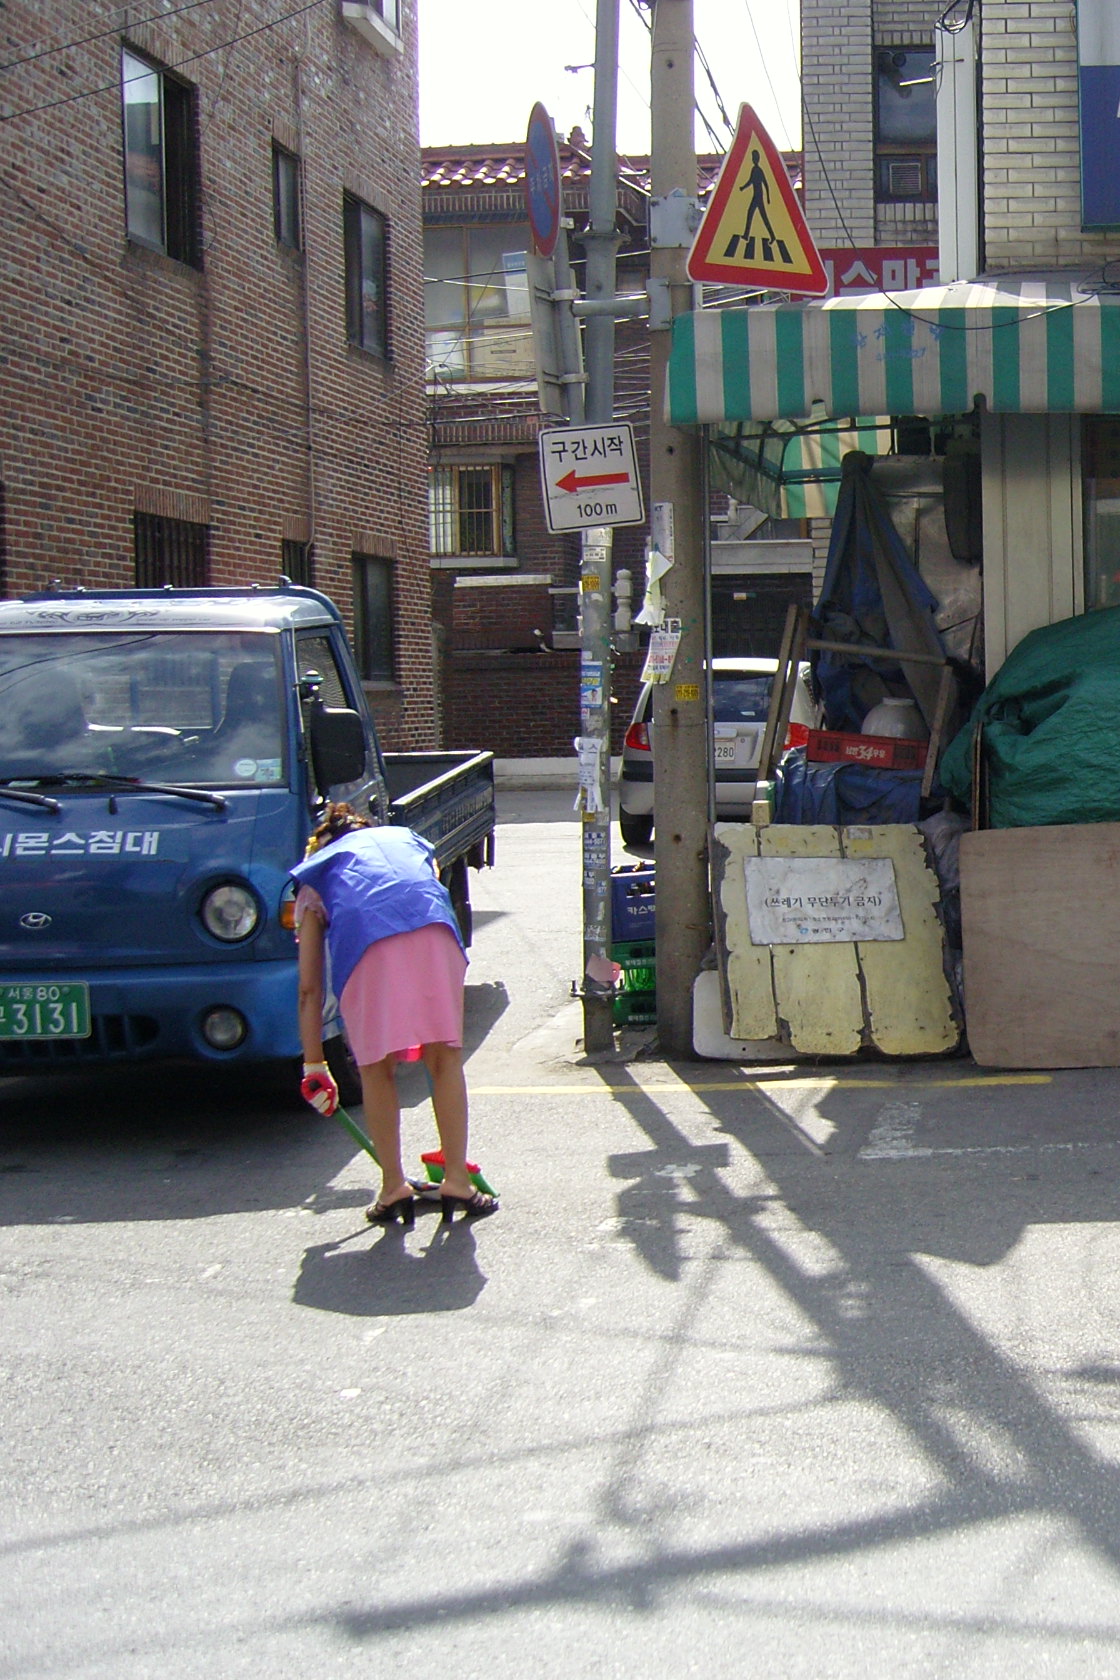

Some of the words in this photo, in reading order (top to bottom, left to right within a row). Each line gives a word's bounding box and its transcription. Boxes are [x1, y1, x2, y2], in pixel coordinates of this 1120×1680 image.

[551, 435, 624, 463] 구간시작
[764, 895, 803, 908] (쓰레기
[807, 895, 851, 908] 무단투기
[854, 895, 882, 908] 금지)
